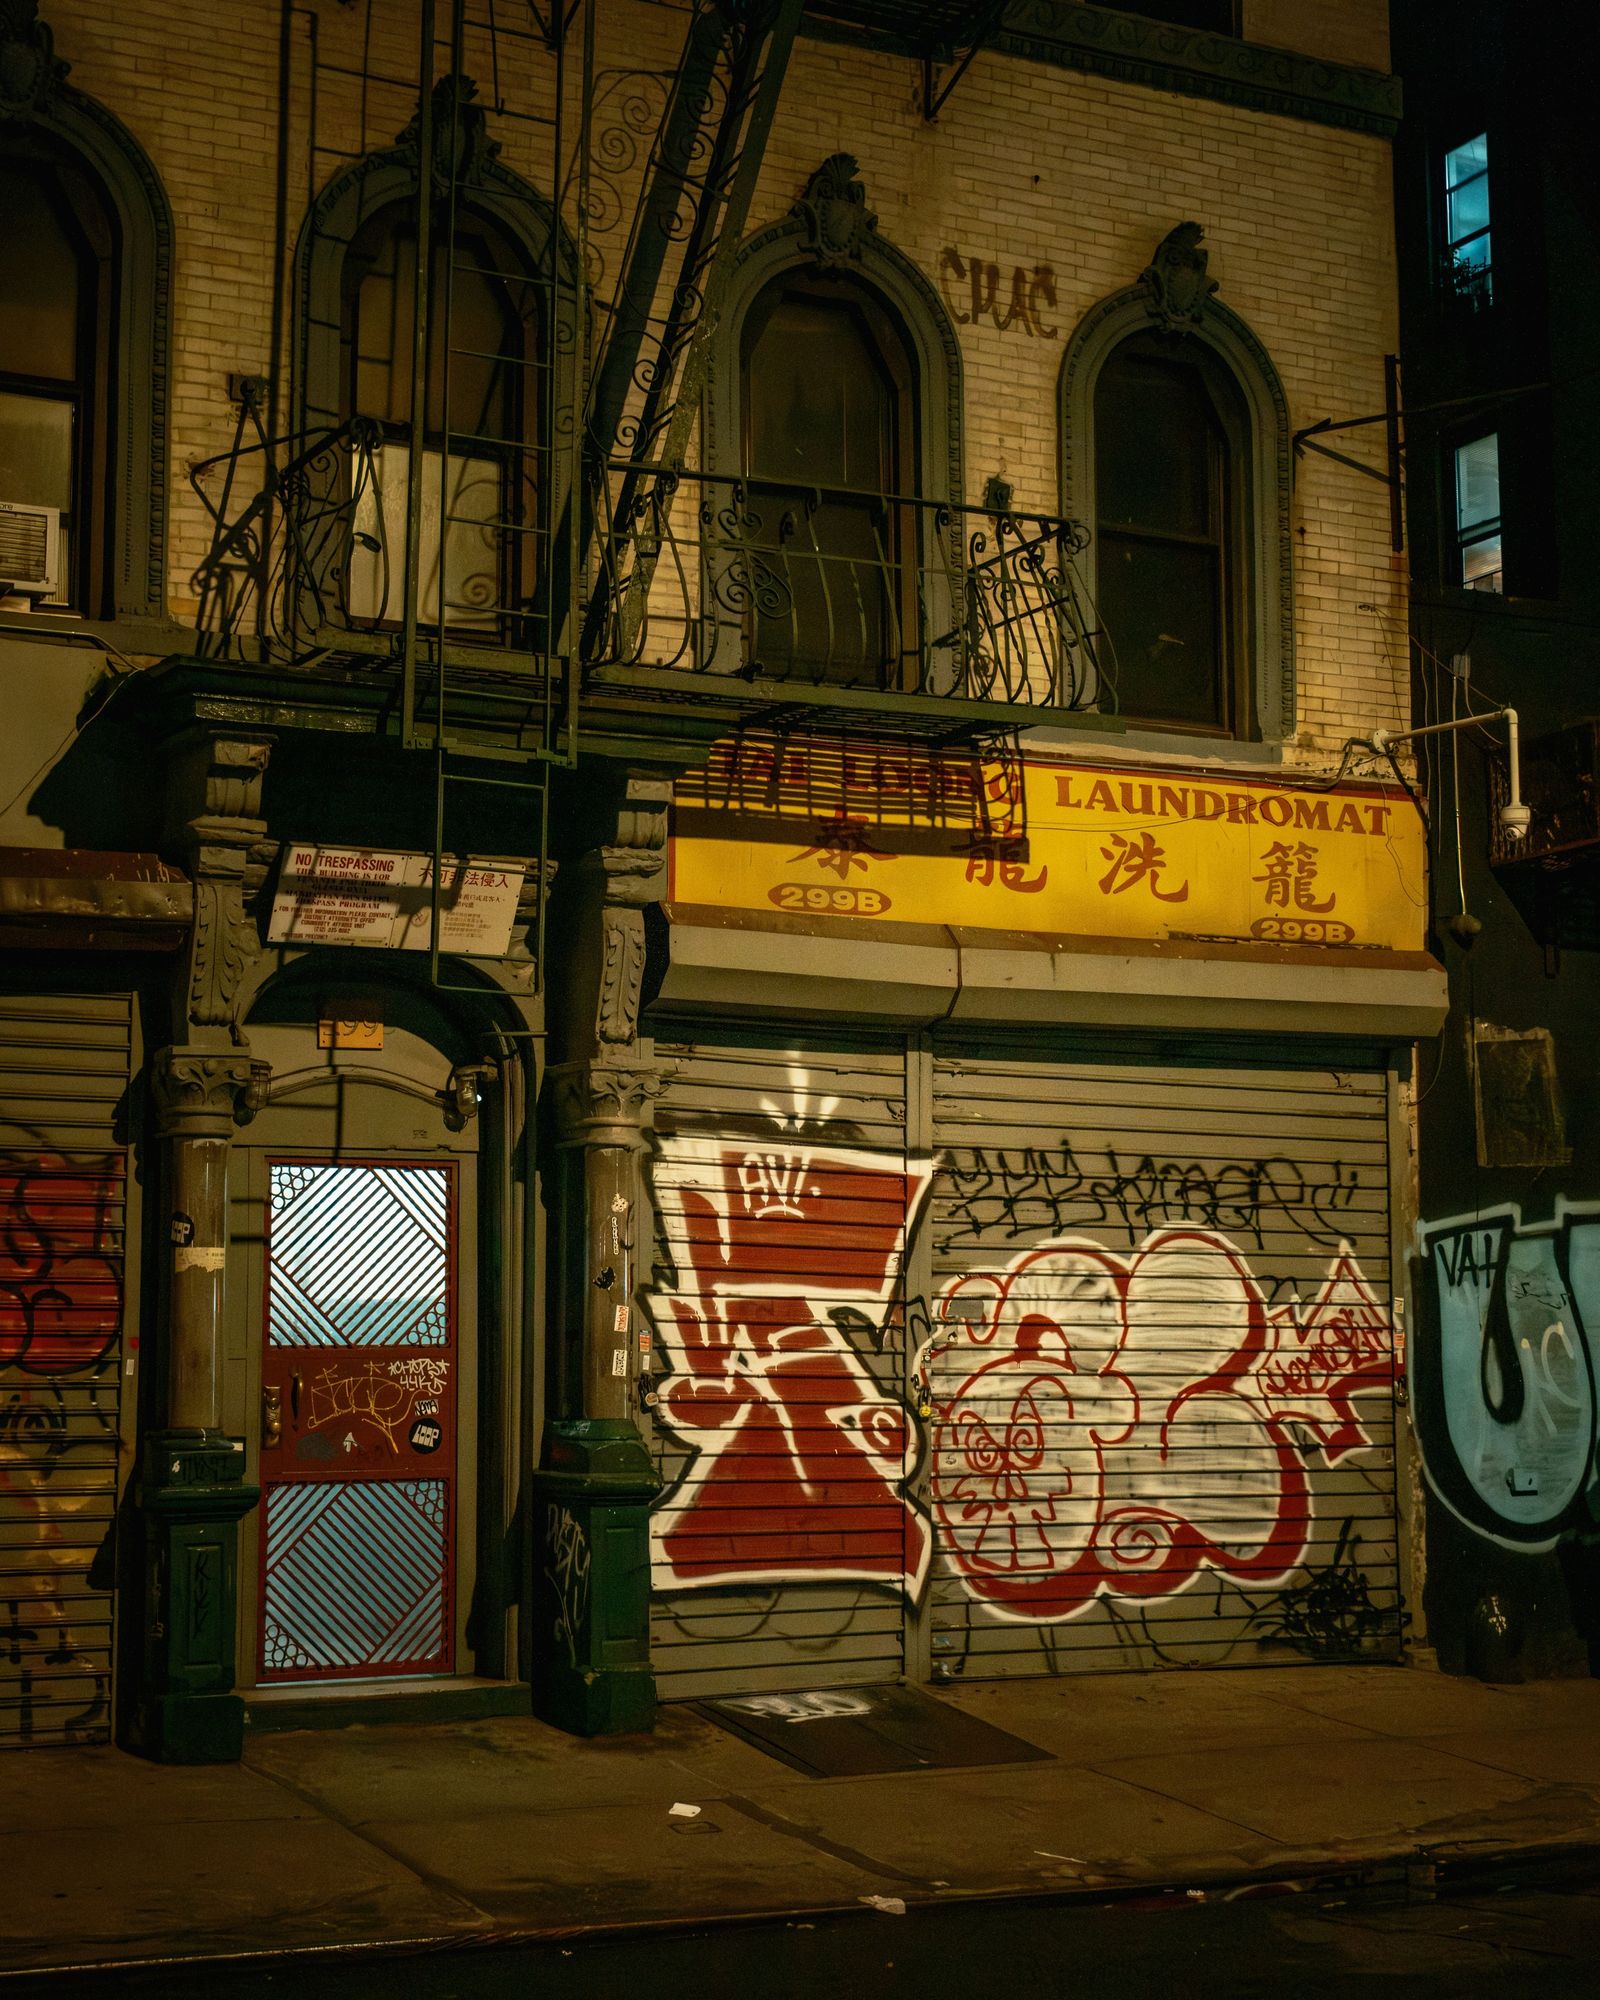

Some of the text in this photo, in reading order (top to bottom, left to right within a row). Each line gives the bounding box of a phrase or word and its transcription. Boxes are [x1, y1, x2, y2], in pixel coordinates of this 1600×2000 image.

[1054, 776, 1391, 836] LAUNDROMAT
[295, 853, 395, 872] NO TRESPASSING
[319, 869, 360, 879] BUILDING
[779, 886, 882, 914] 299B
[1260, 921, 1347, 943] 299B
